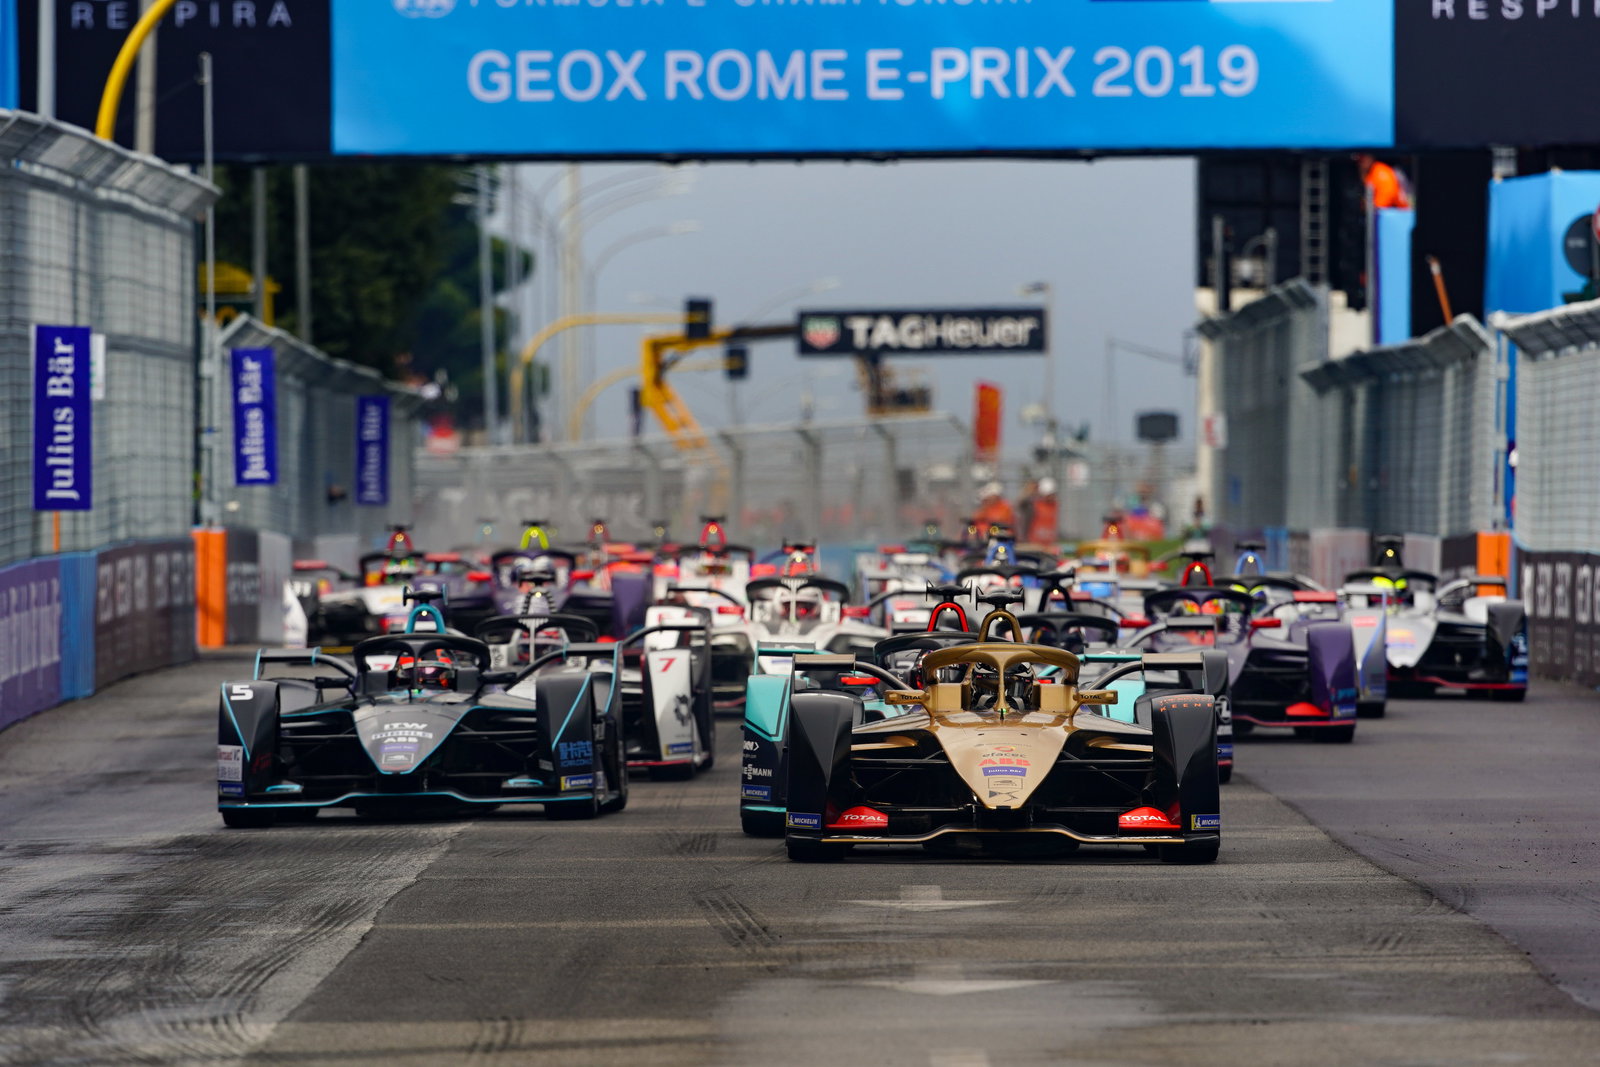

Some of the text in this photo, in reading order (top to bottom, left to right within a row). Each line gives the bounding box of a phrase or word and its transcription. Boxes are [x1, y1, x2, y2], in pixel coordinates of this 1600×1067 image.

[71, 0, 292, 30] REPIRA
[1431, 0, 1600, 20] RESPI
[467, 45, 1259, 102] GEOX ROME E-PRIX 2019
[45, 336, 80, 501] Julius Bär
[240, 407, 271, 480] Julius
[658, 657, 677, 673] 7
[230, 684, 254, 701] 5
[978, 758, 1031, 766] ABB
[794, 817, 818, 825] MICHELIN
[843, 814, 885, 822] TOTAL
